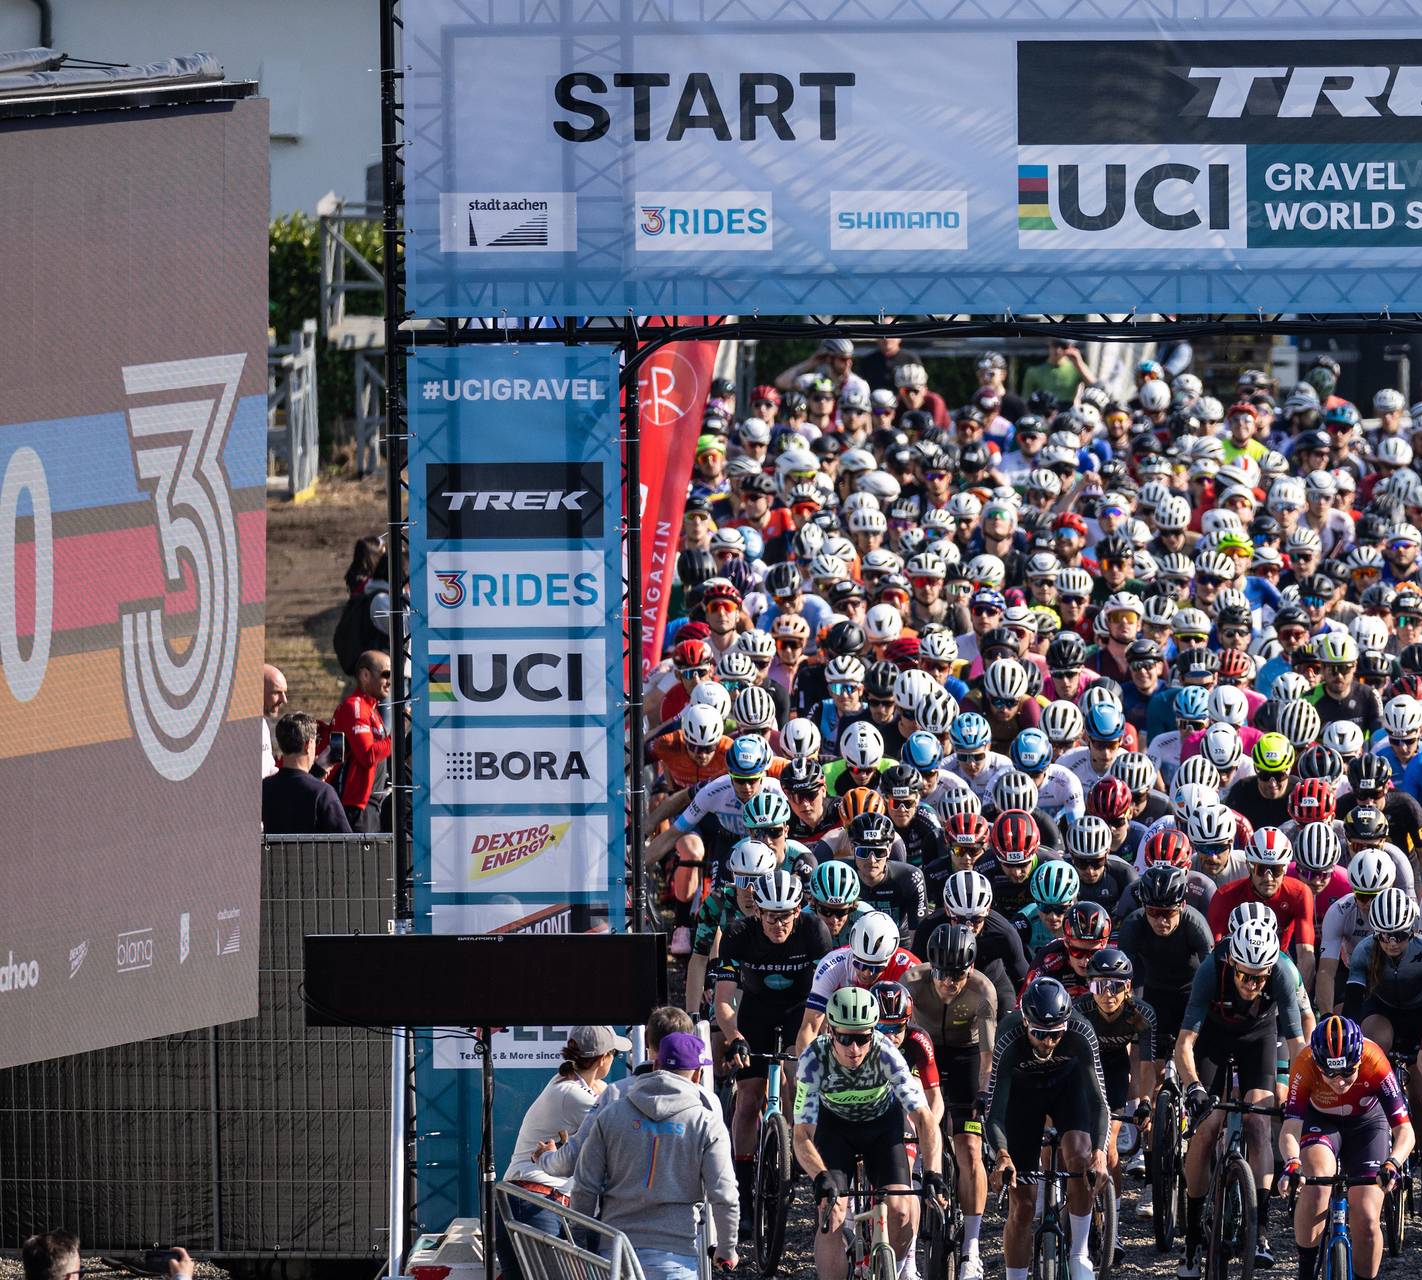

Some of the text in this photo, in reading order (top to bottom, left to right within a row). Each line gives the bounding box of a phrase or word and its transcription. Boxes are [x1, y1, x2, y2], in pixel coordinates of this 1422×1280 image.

[552, 72, 855, 142] START
[1265, 163, 1406, 191] GRAVEL
[468, 198, 548, 212] stadt aachen
[1058, 163, 1230, 230] UCI
[838, 211, 960, 229] SHIMANO
[1265, 202, 1396, 230] WORLD
[423, 379, 605, 401] #UCIGRAVEL
[441, 490, 589, 511] TREK
[643, 521, 671, 643] MAGAZIN
[458, 653, 582, 702] UCI
[474, 751, 590, 781] BORA
[471, 824, 550, 854] DEXTRO
[480, 836, 550, 872] ENERGY
[0, 951, 39, 992] ahoo
[460, 1052, 498, 1060] Texts
[510, 1052, 534, 1060] More
[536, 1051, 561, 1060] since
